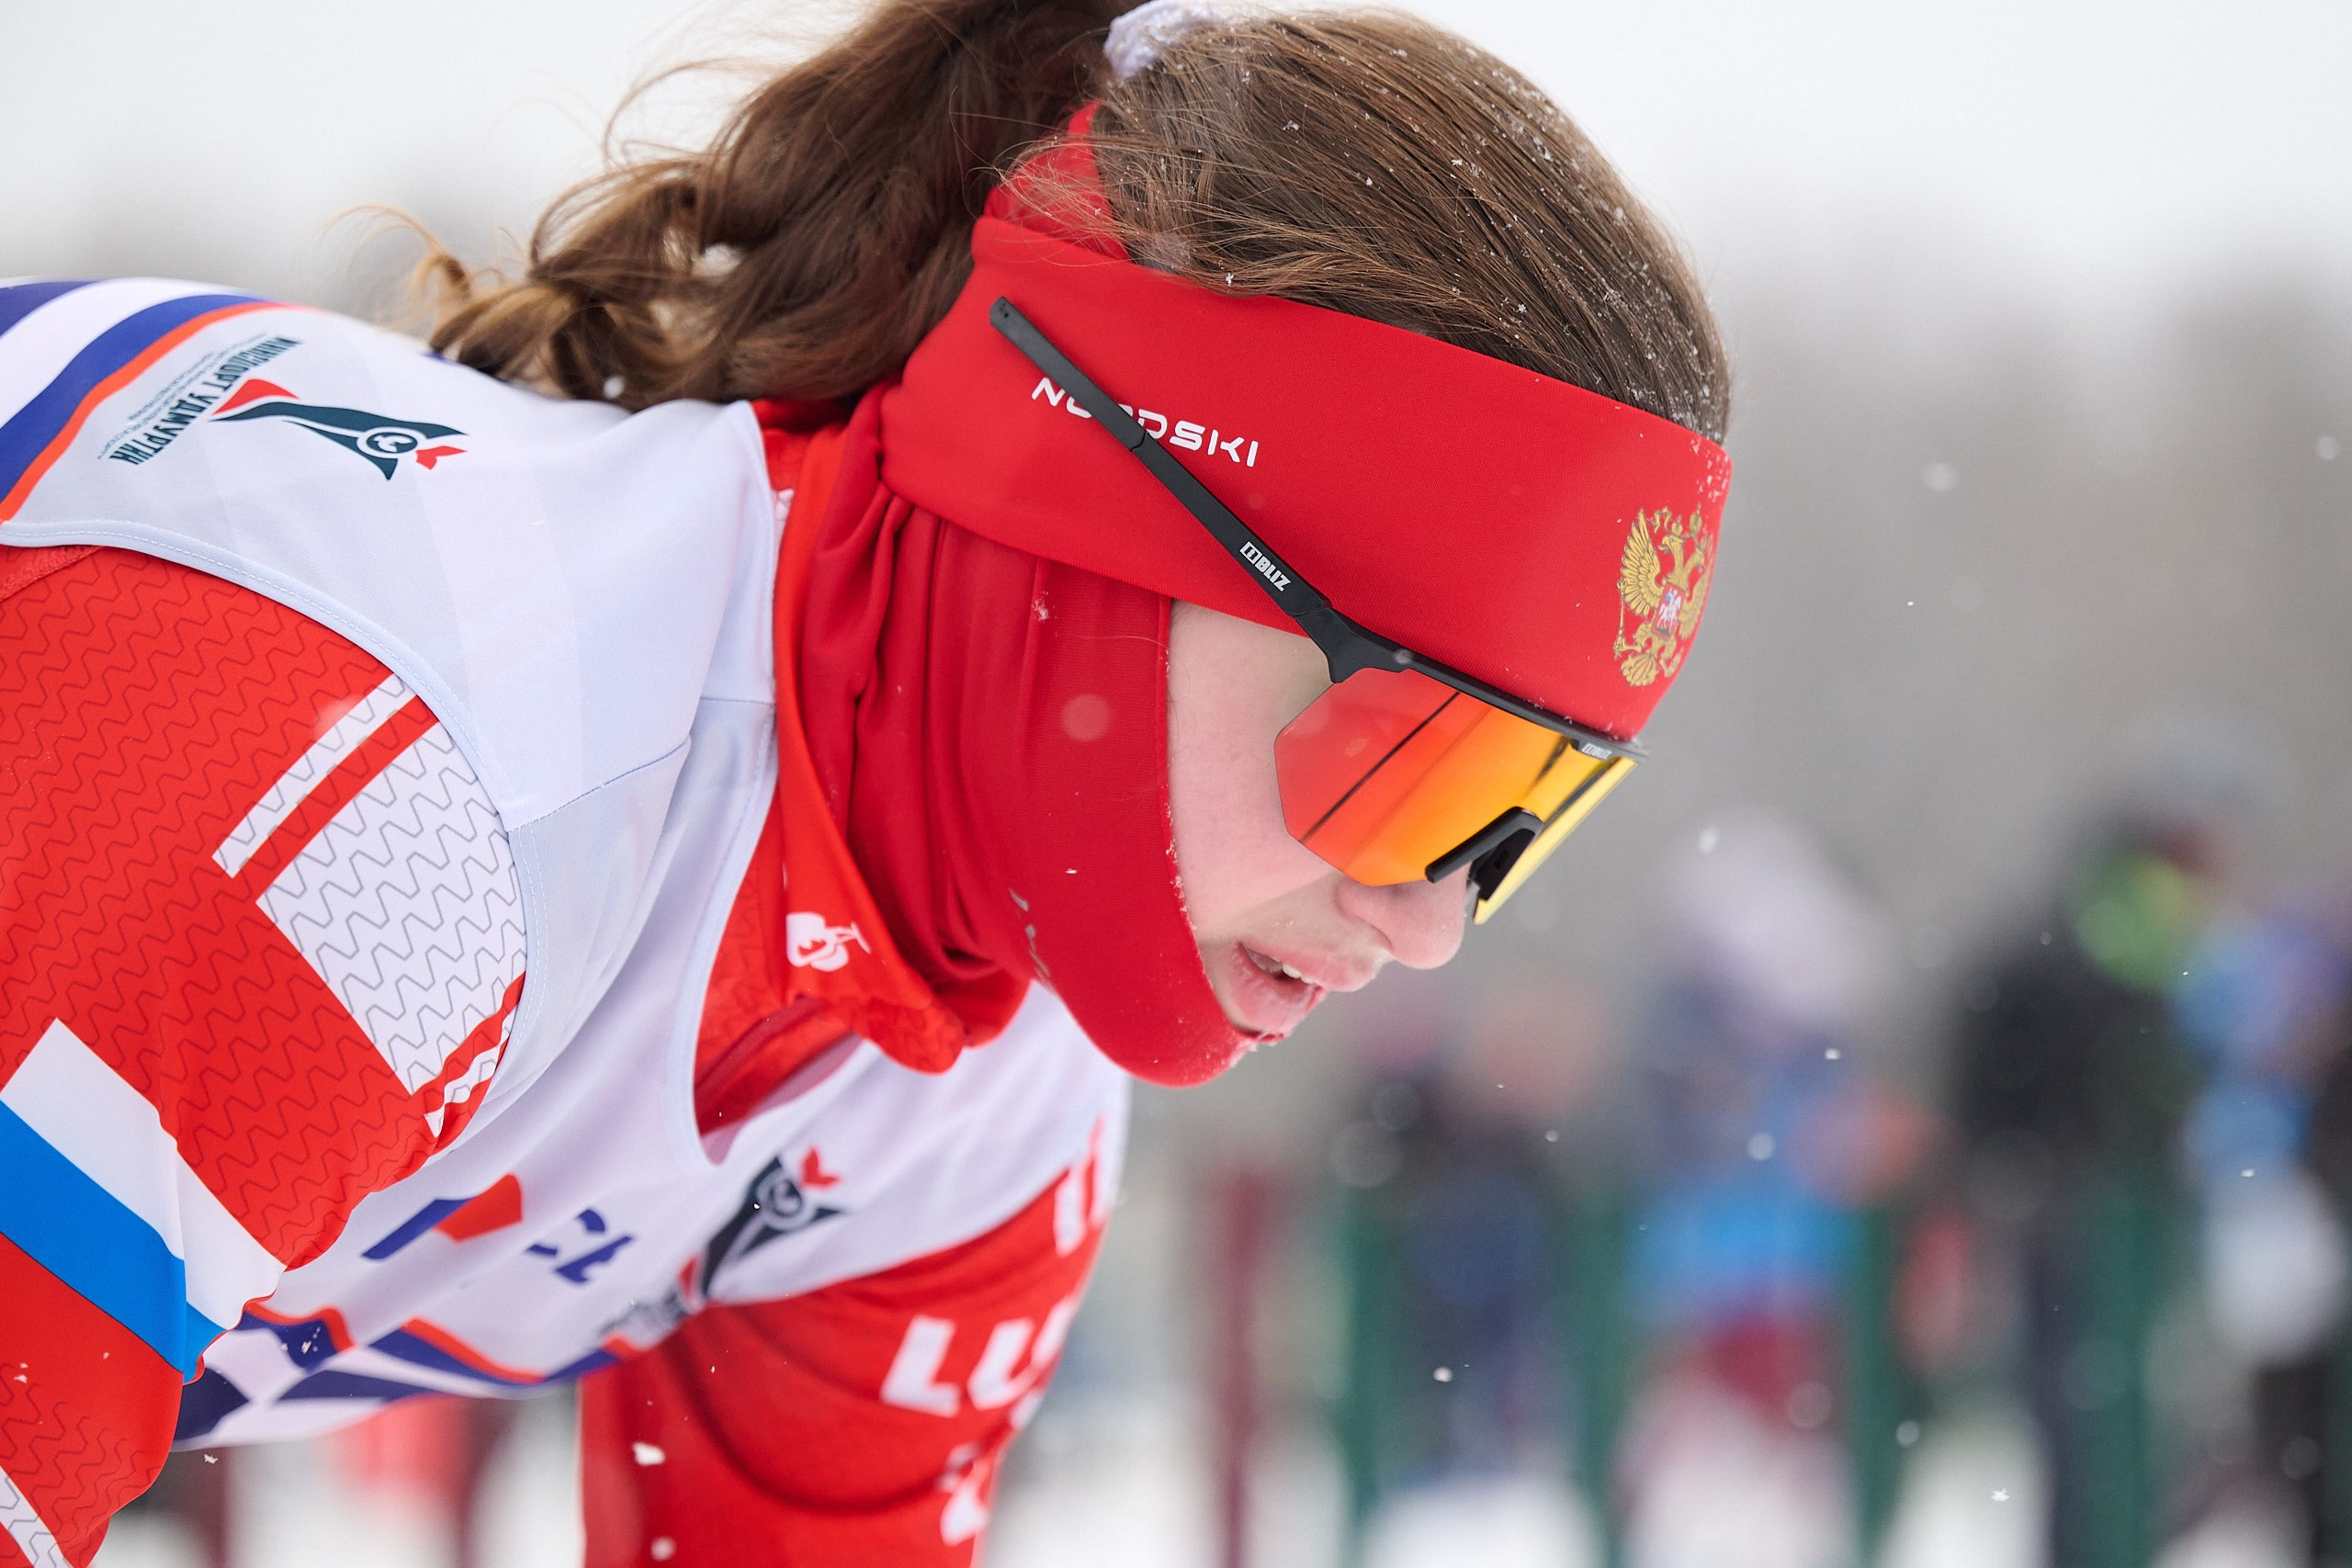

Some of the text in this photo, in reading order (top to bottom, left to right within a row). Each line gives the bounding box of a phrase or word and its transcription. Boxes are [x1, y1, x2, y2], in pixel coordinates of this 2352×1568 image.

[109, 392, 220, 466] УДМУРТИИ
[1254, 556, 1293, 592] BLIZ
[879, 1296, 1073, 1429] LU
